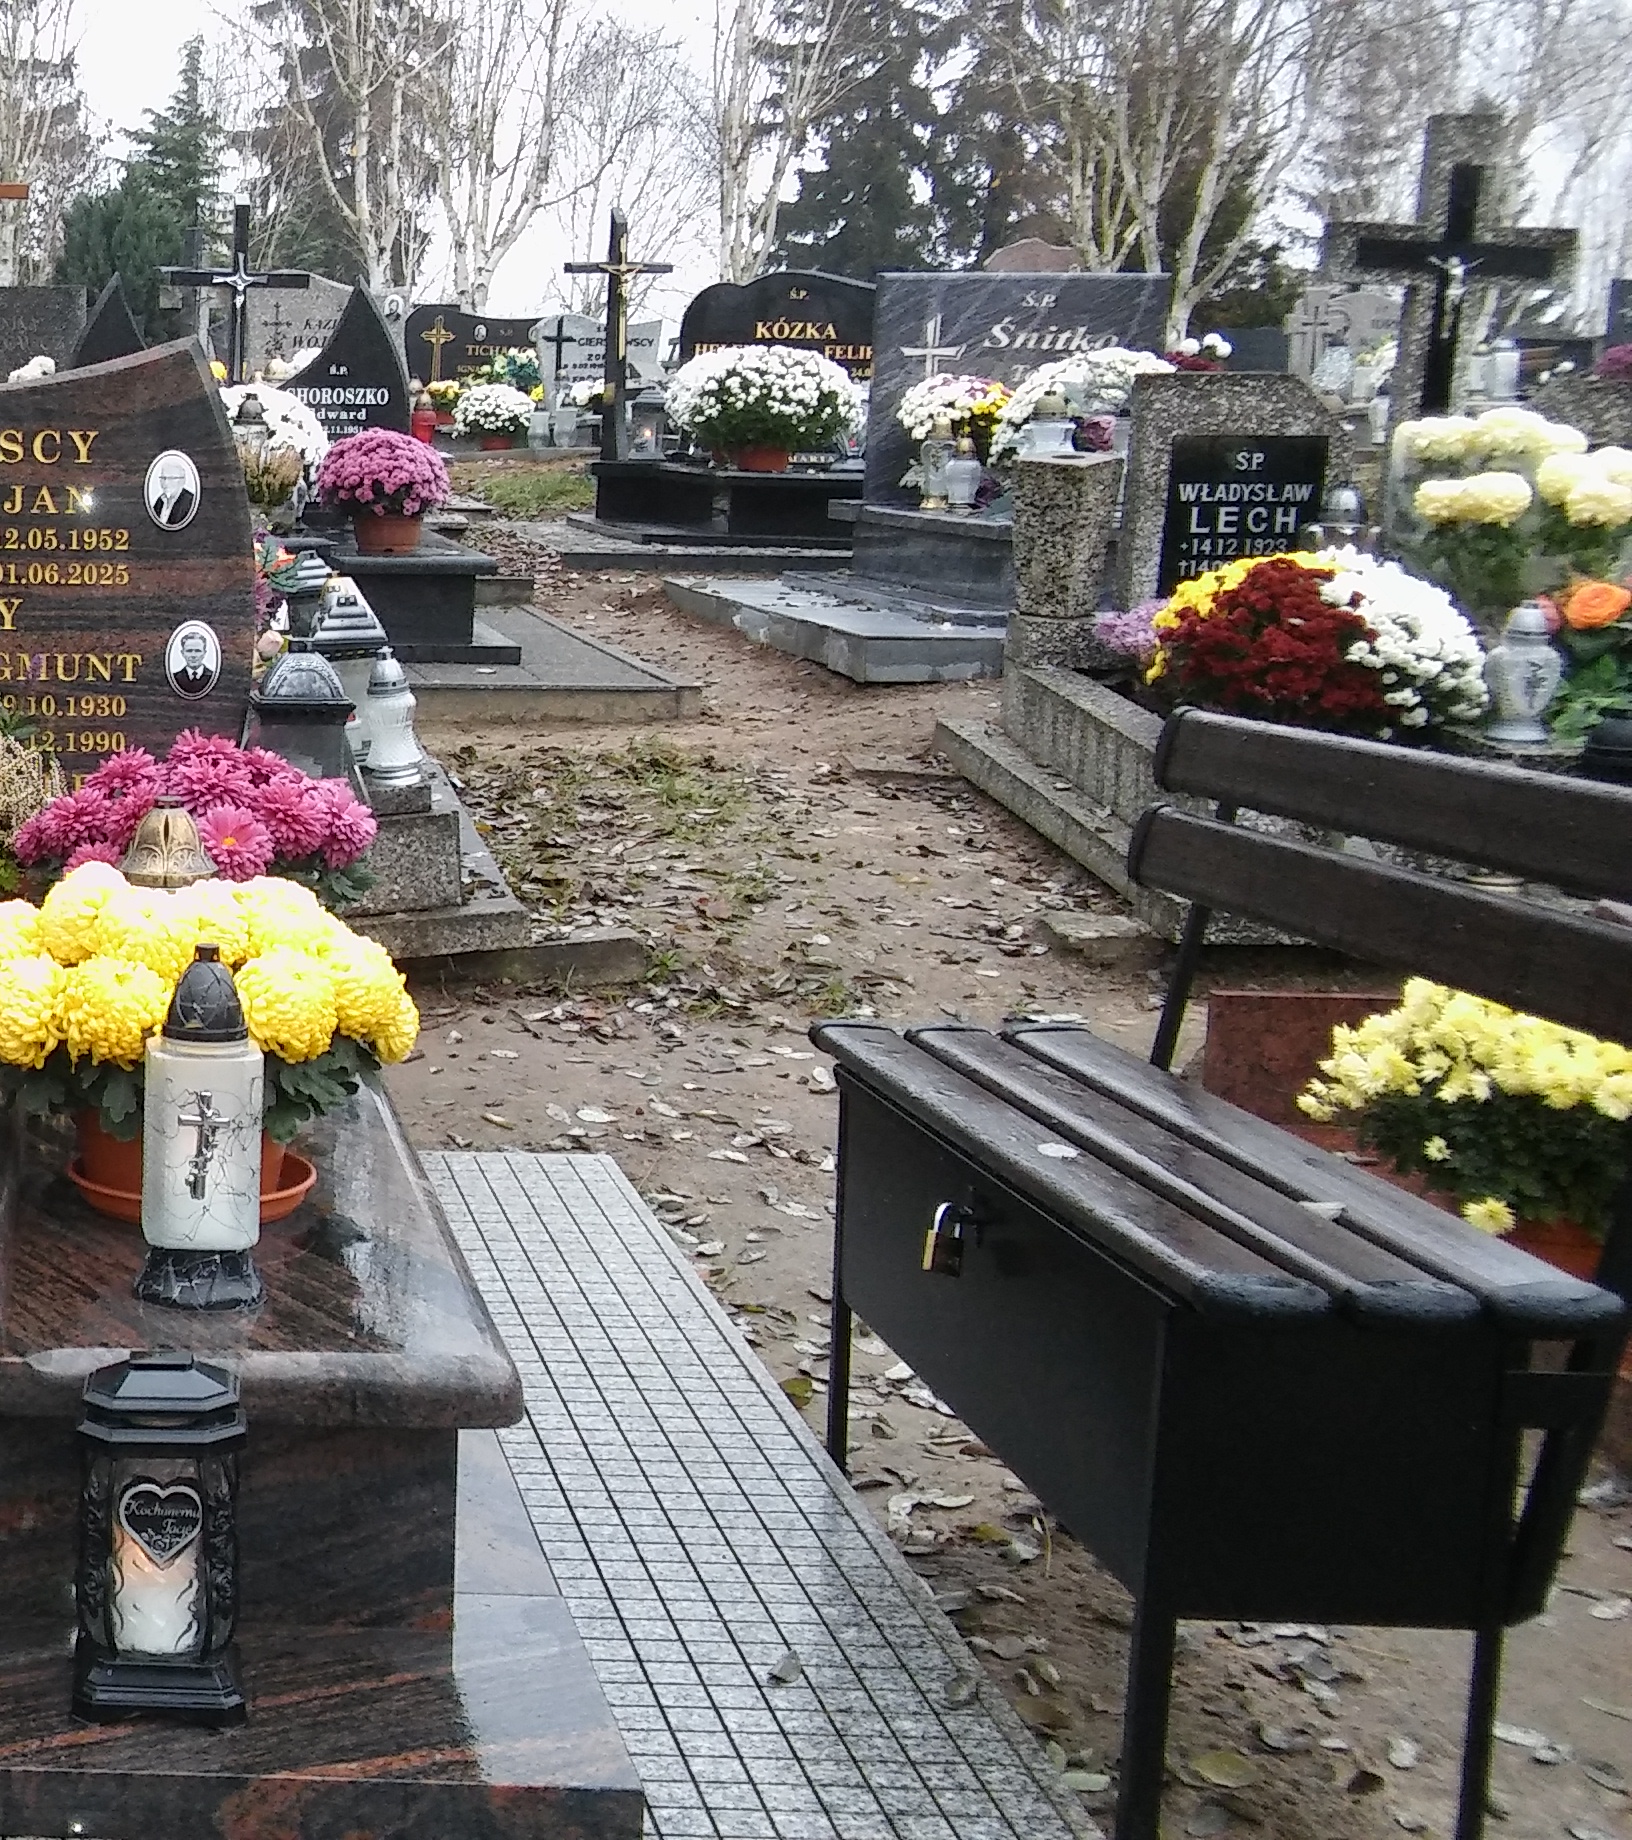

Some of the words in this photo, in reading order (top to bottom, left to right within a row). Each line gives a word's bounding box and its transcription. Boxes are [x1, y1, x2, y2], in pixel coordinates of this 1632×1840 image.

[755, 316, 837, 340] KÓZKA
[982, 316, 1119, 351] Śnitko
[824, 345, 873, 360] FELI
[309, 408, 367, 420] dward
[3, 485, 95, 515] JAN
[1178, 483, 1314, 502] WŁADYSŁAW
[1189, 506, 1298, 534] LECH
